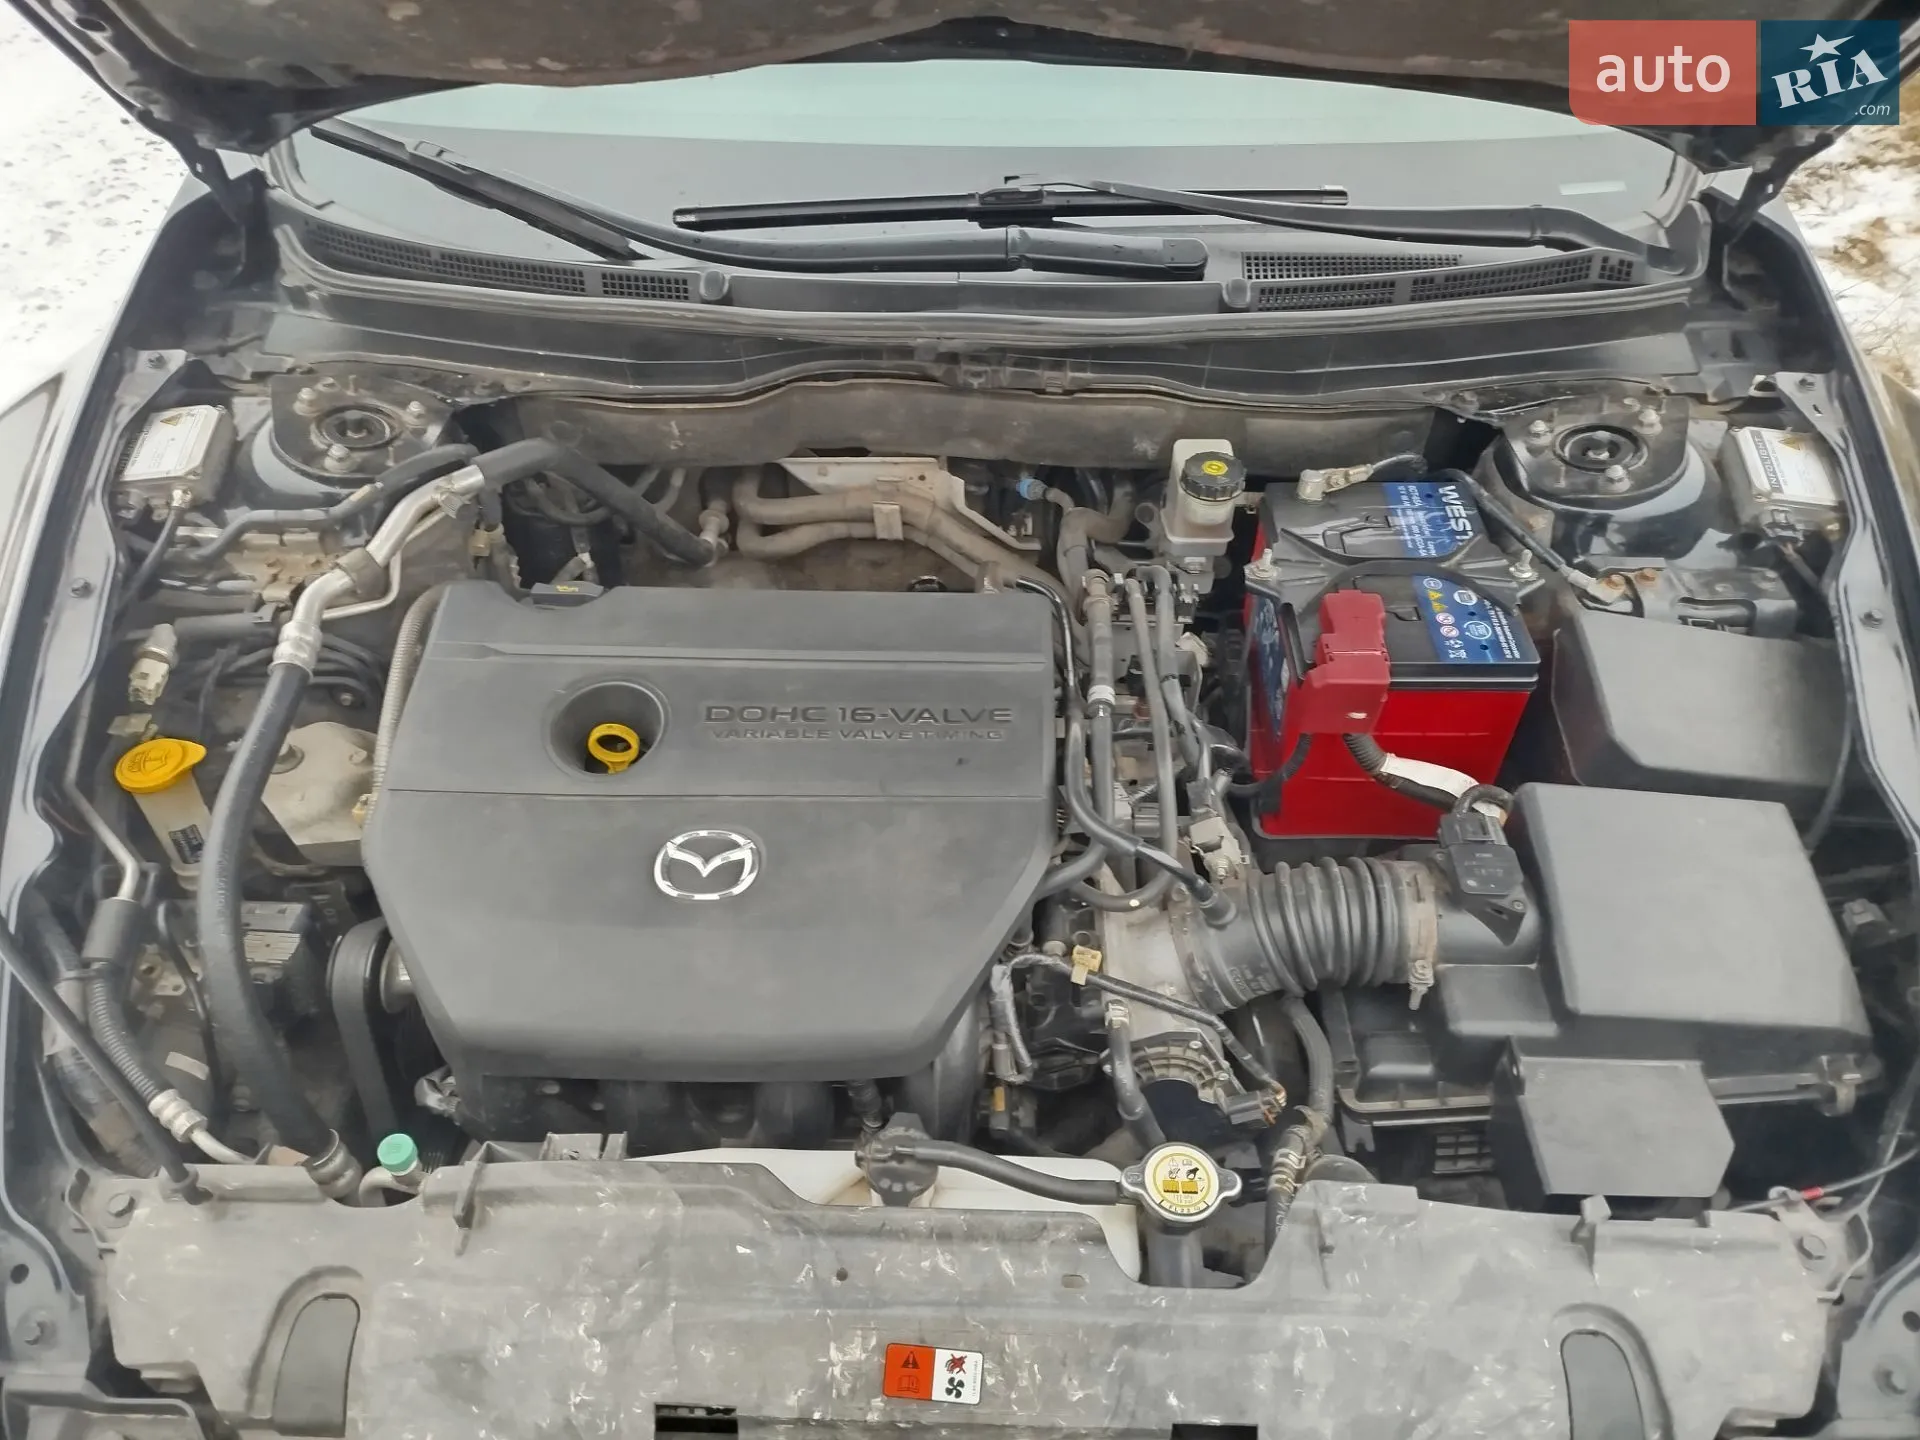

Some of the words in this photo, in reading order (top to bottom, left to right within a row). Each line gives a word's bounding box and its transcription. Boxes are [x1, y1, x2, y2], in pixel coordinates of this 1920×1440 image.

[1437, 485, 1474, 546] WEST
[704, 705, 829, 723] DOHC
[837, 706, 1013, 725] 16-VALVE
[711, 728, 830, 740] VARIABLE
[838, 729, 914, 740] VALVE
[919, 729, 1003, 740] TIMING
